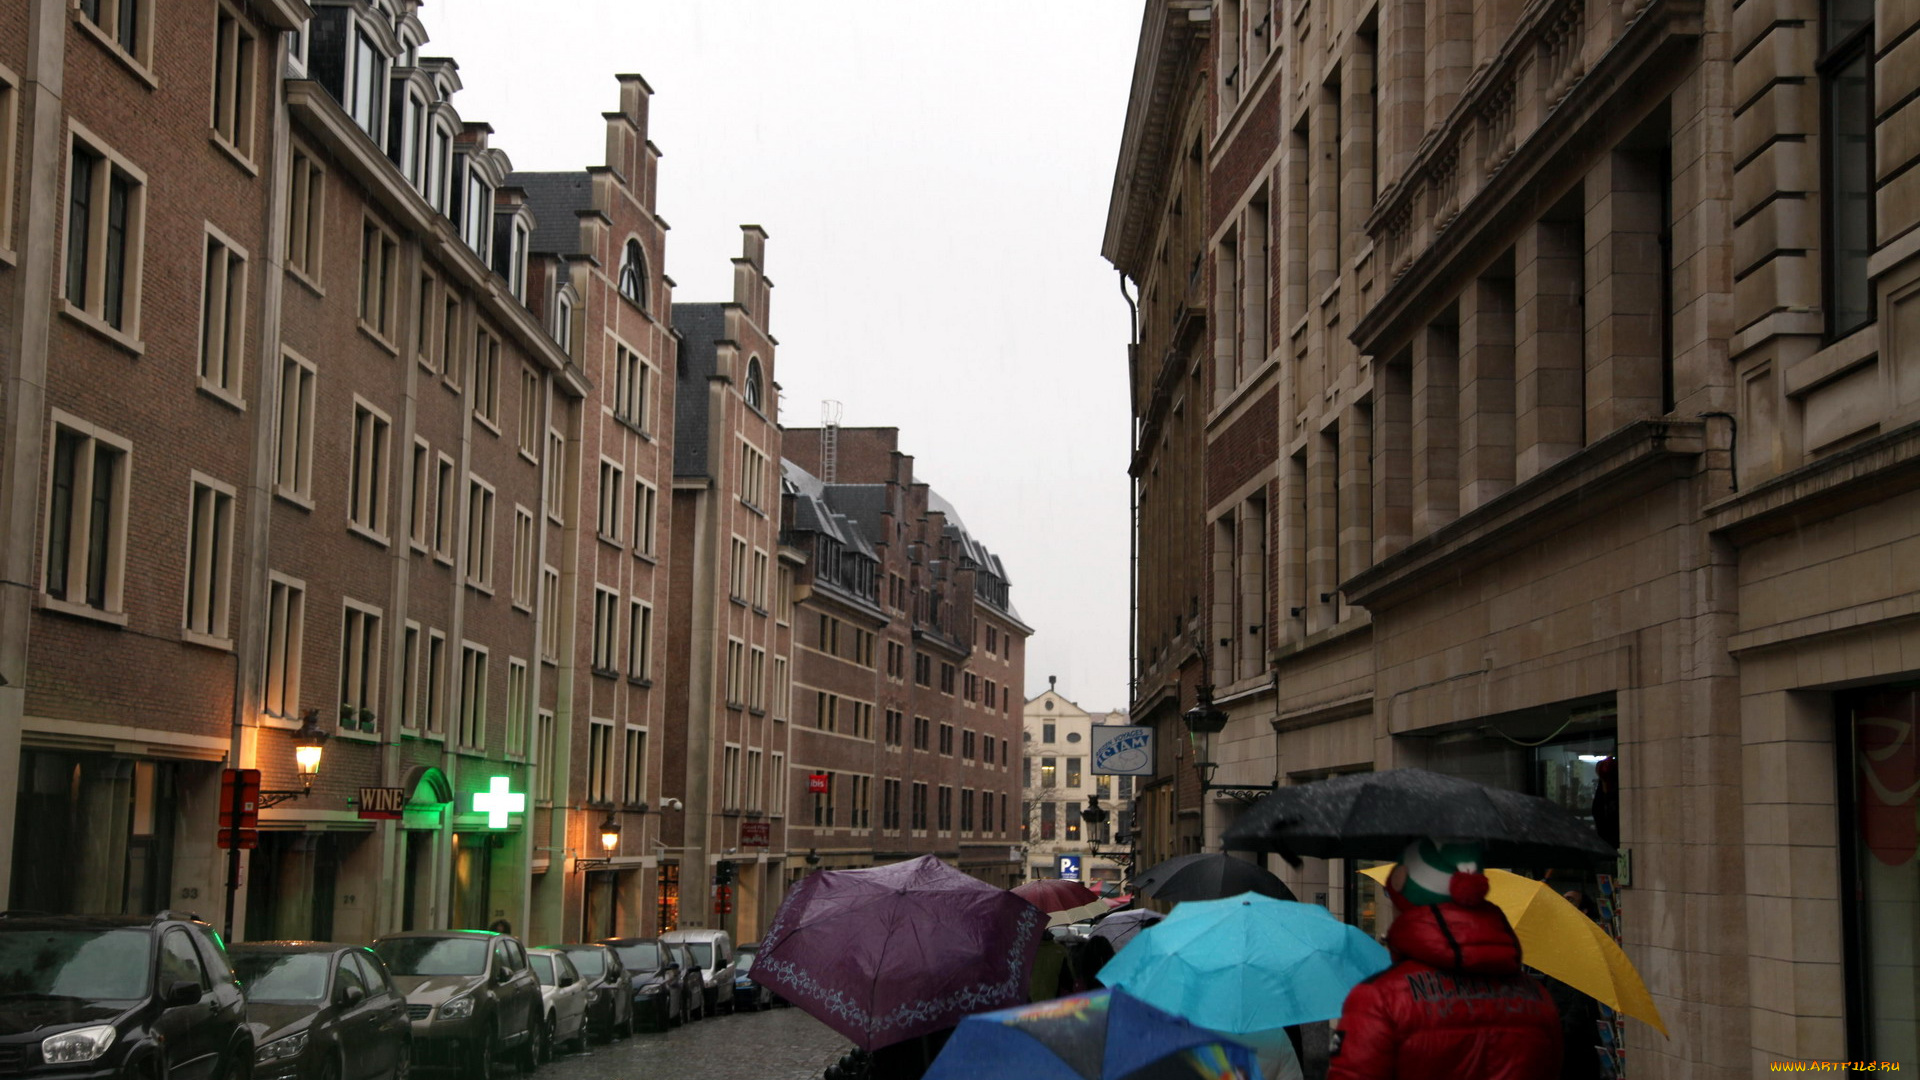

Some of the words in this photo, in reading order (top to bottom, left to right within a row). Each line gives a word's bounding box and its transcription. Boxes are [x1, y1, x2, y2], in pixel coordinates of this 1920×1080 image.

[1114, 729, 1144, 743] VOYAGES
[811, 778, 824, 787] ibis
[361, 788, 403, 811] WINE
[1061, 858, 1071, 873] P
